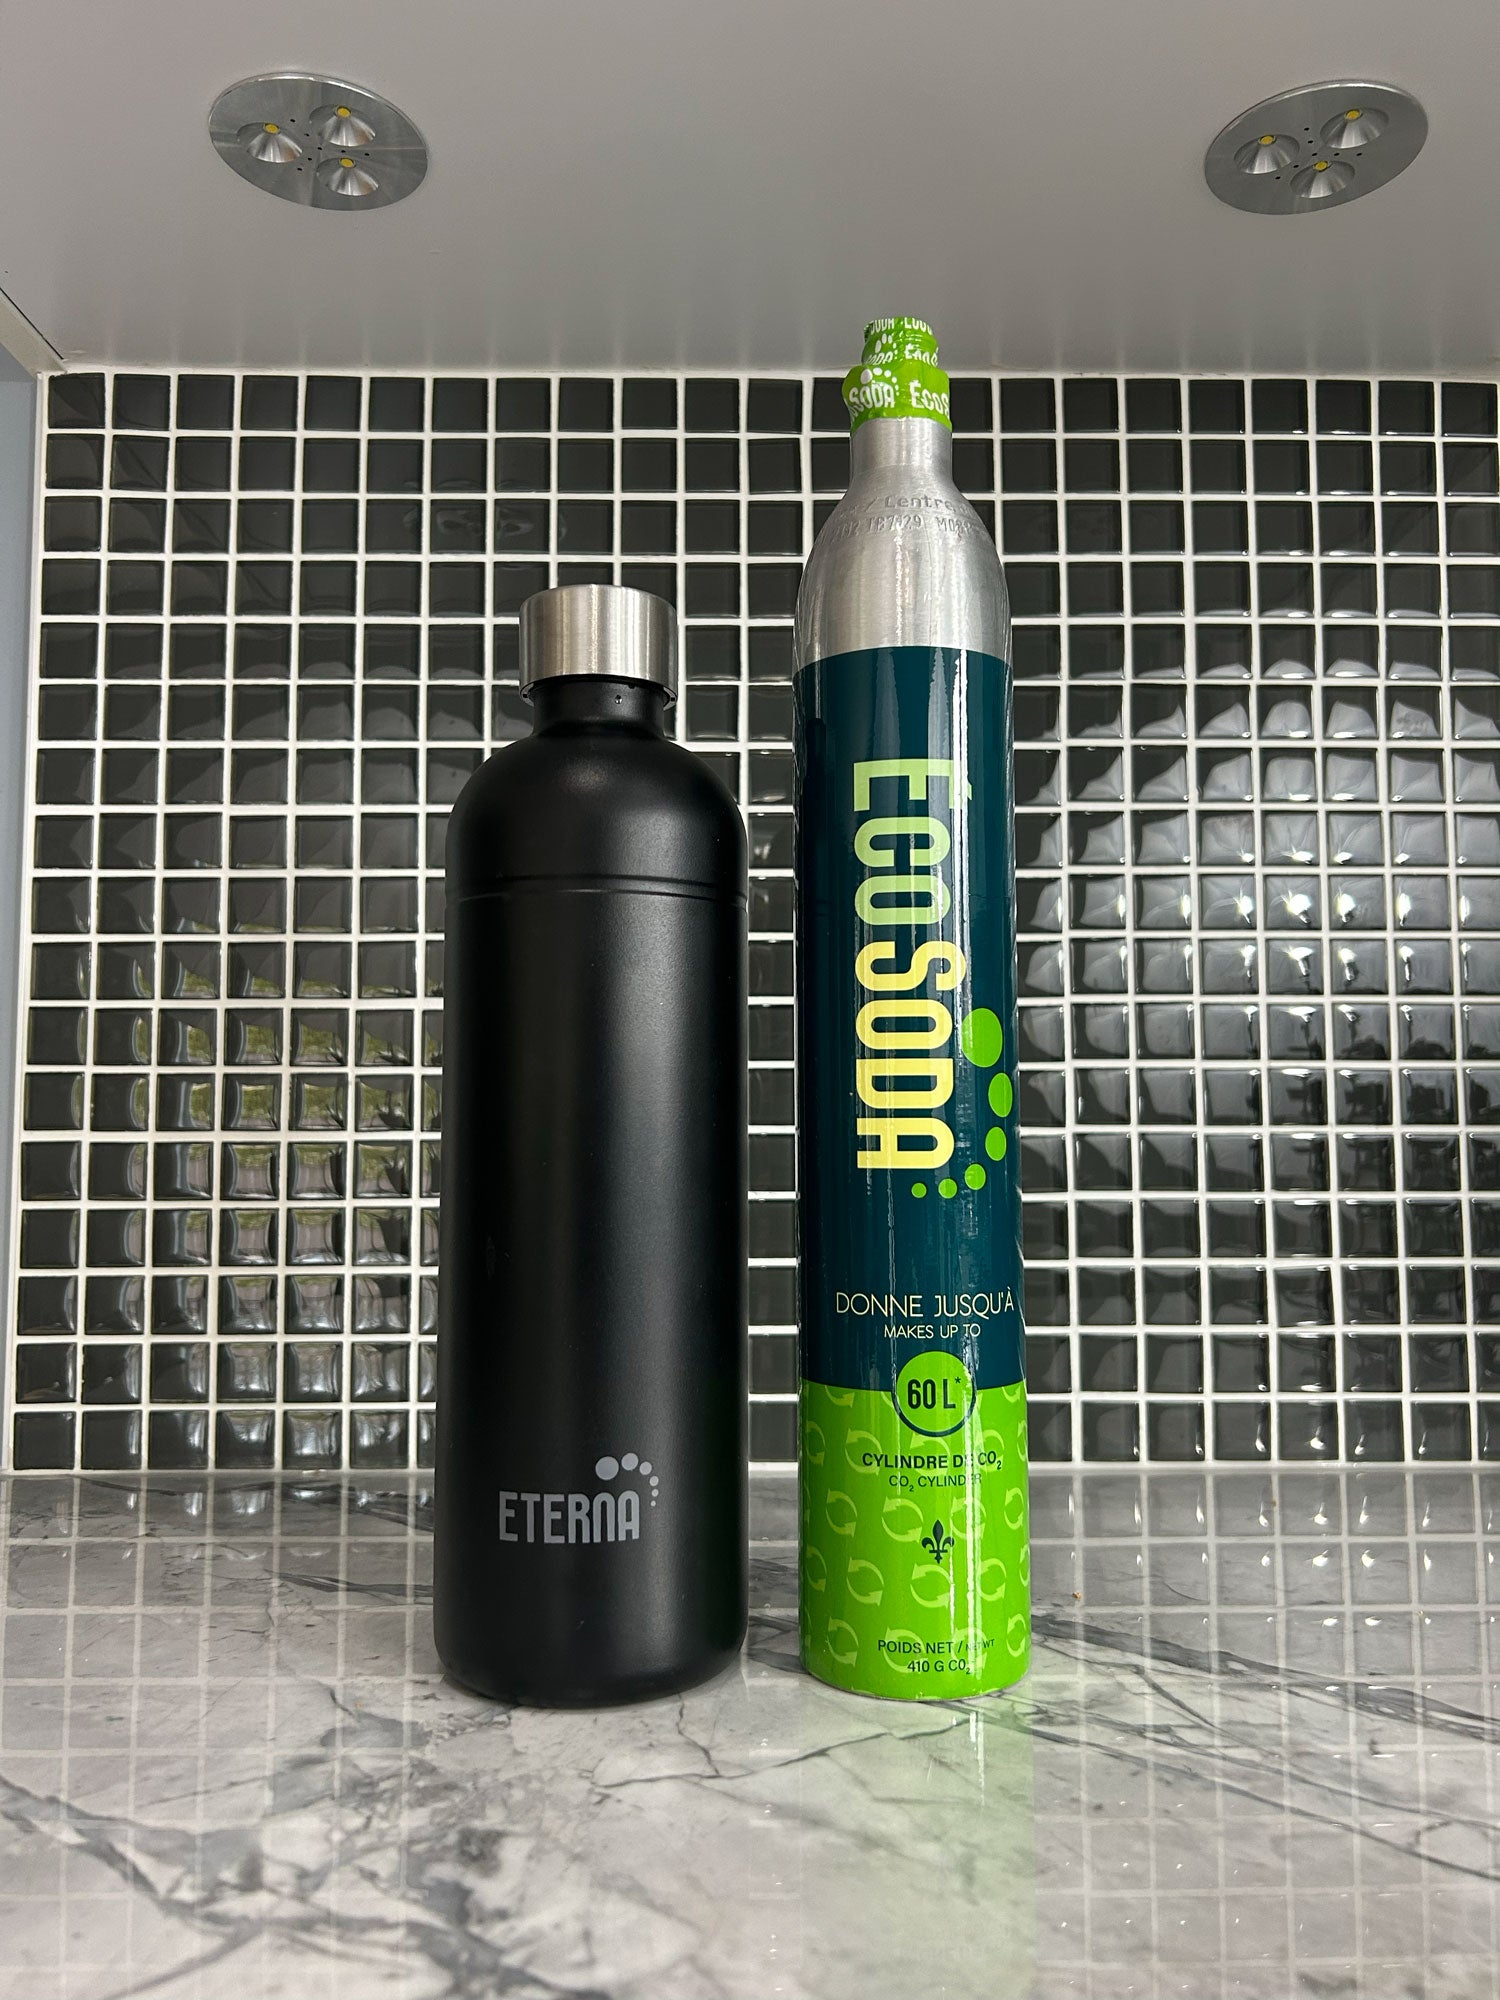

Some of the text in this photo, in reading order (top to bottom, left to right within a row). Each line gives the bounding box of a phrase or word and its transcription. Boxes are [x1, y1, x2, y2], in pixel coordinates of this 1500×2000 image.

[836, 1286, 1015, 1320] DONNE JUSQU'À
[884, 1323, 981, 1339] MAKES UP TO
[907, 1378, 936, 1410] 60
[862, 1452, 948, 1469] CYLINDRE
[917, 1473, 982, 1488] CYLINDR
[499, 1490, 640, 1544] ETERNA
[878, 1640, 921, 1654] POIDS
[926, 1641, 953, 1654] NET
[983, 1639, 995, 1649] WT
[907, 1660, 930, 1673] 410
[934, 1660, 944, 1672] G
